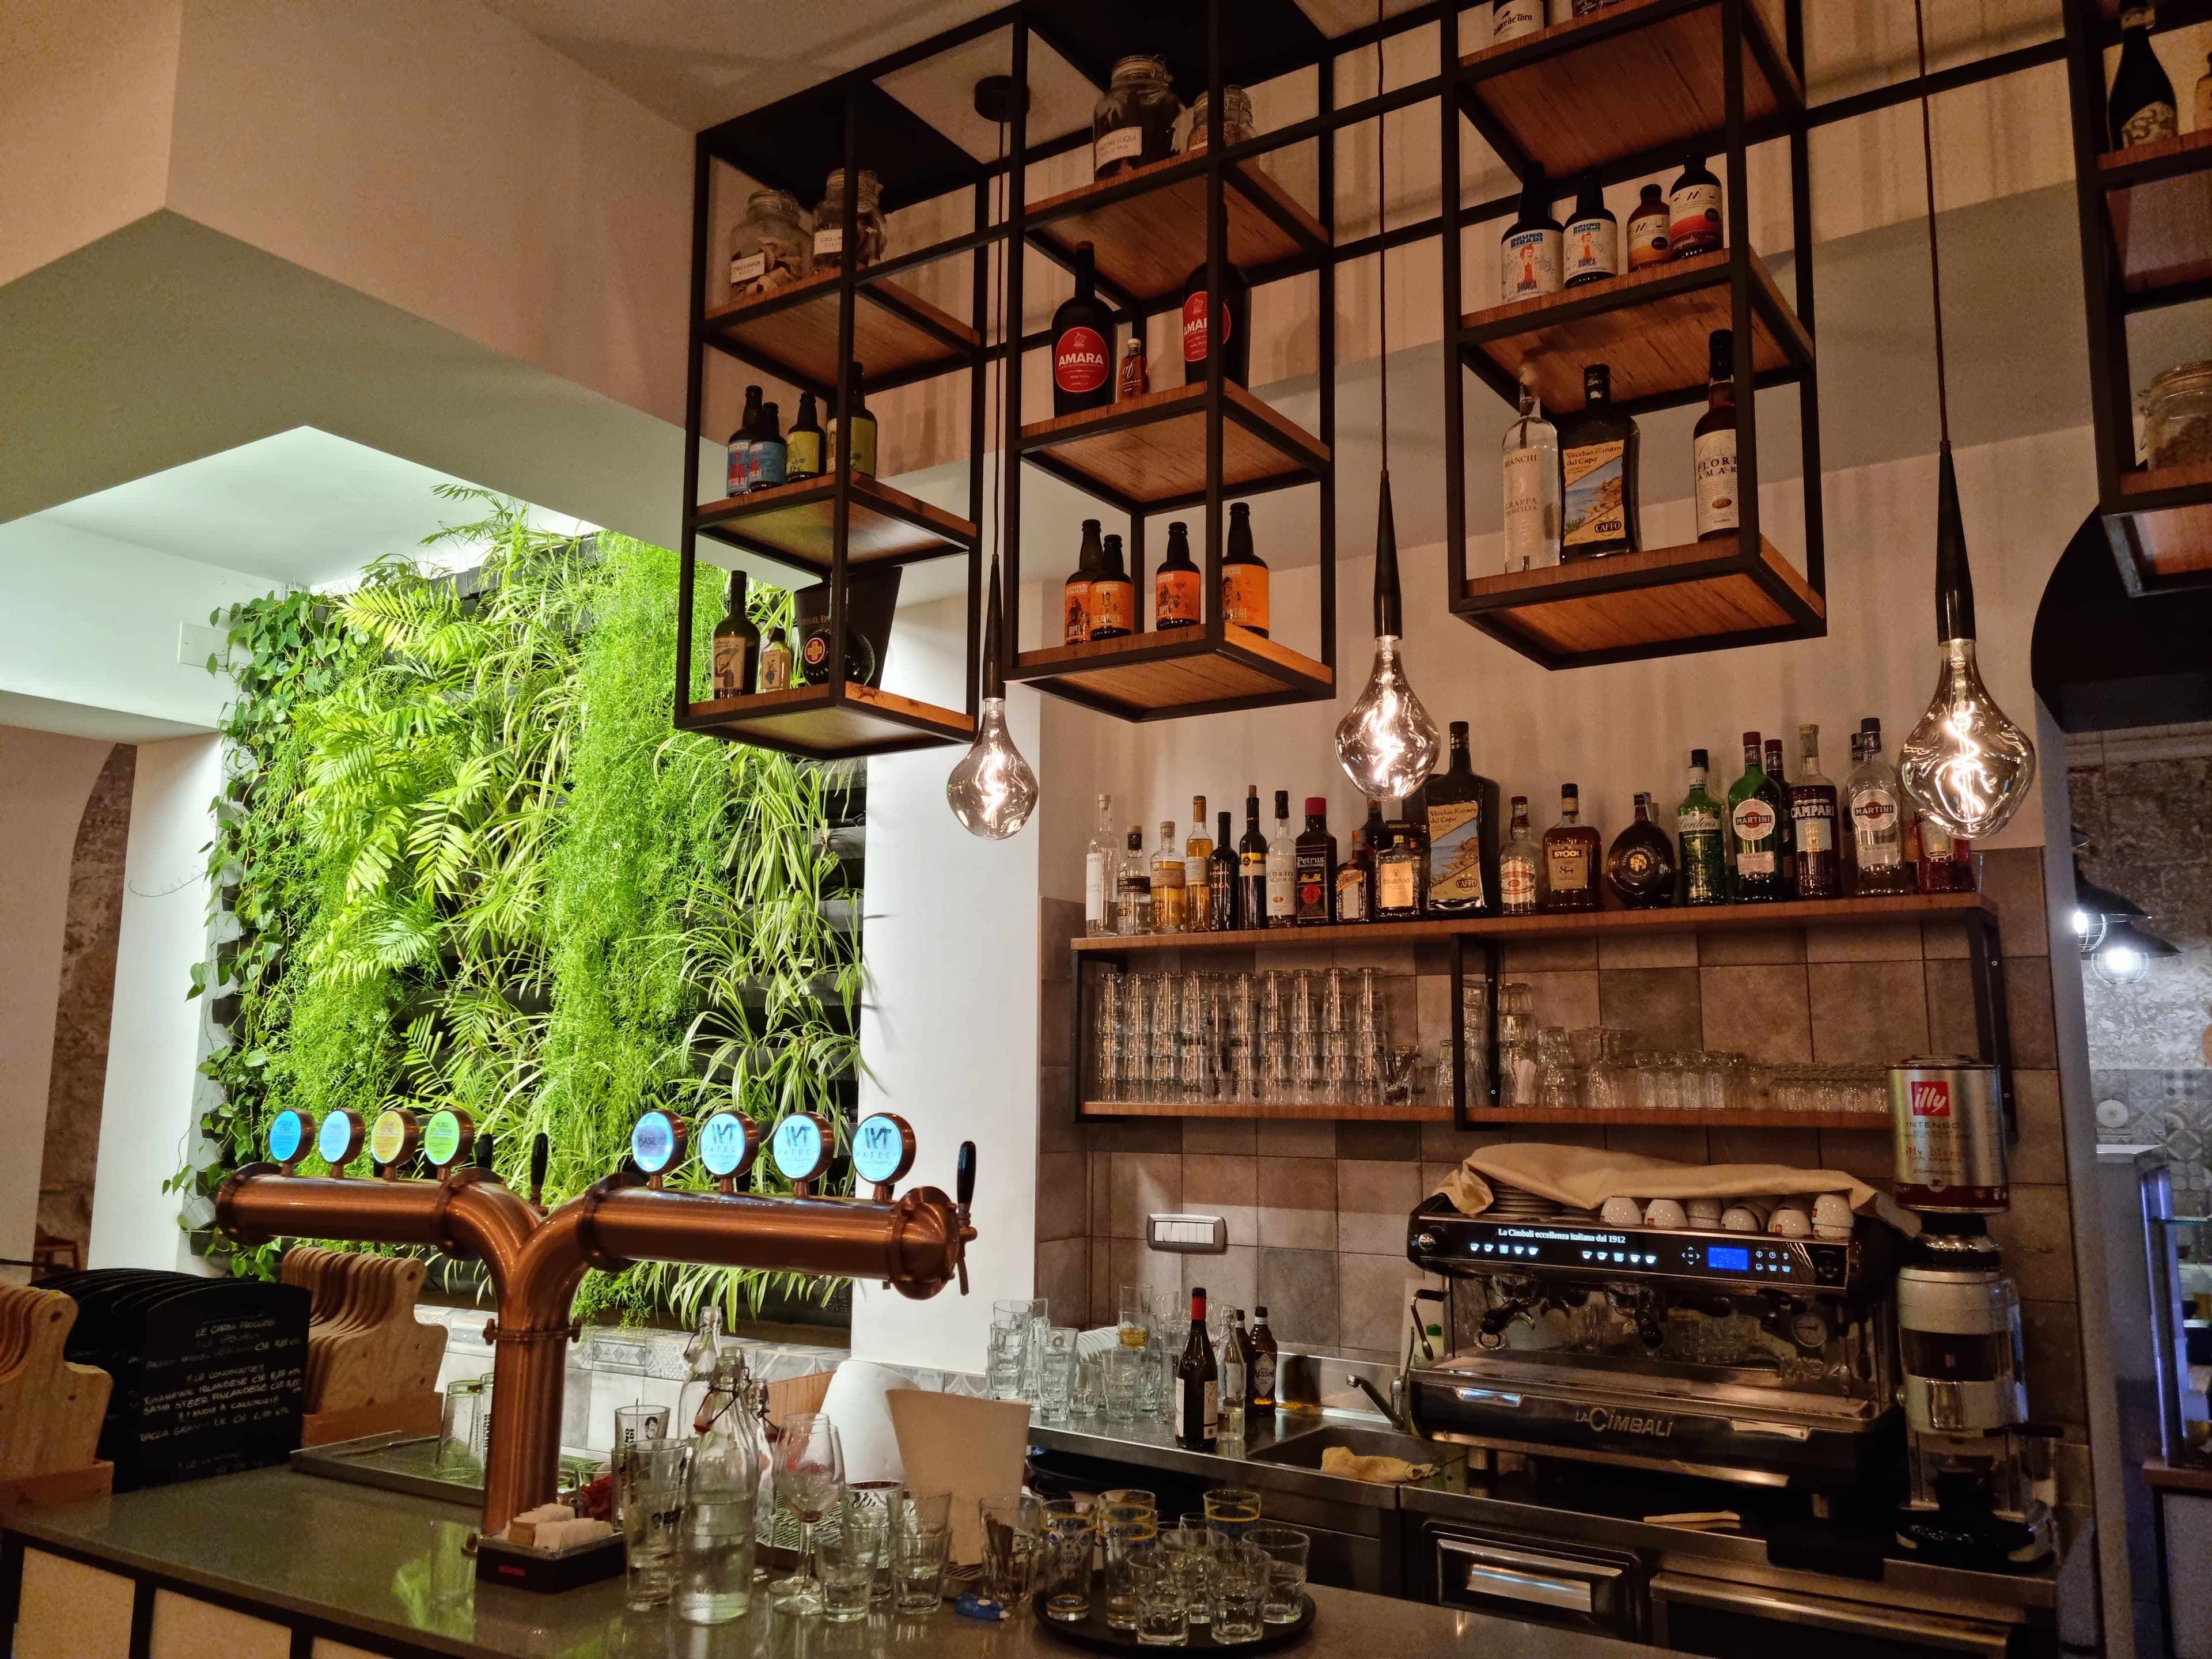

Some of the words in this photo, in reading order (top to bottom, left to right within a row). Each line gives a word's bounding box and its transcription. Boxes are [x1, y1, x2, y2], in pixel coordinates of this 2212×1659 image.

[1517, 13, 1532, 21] Toro
[1574, 222, 1601, 231] BRUNO
[1510, 232, 1543, 244] BRUNO
[1578, 257, 1596, 268] BIANCA
[1517, 279, 1537, 293] BIANCA
[1058, 352, 1104, 367] AMARA
[1504, 454, 1537, 468] BIANCHI
[1566, 450, 1593, 459] Vecchio
[1578, 457, 1597, 465] Capo
[1698, 456, 1737, 474] FLORI
[1698, 466, 1737, 482] AMAR
[1505, 497, 1537, 511] GRAPPA
[1596, 521, 1621, 533] CAFFO
[1238, 608, 1248, 618] ALE
[1791, 805, 1835, 819] CAMPARI
[1855, 805, 1893, 815] MARTINI
[1680, 817, 1715, 830] Gordon's
[1736, 816, 1771, 825] MARTINI
[1622, 848, 1636, 866] VECCHIA
[1636, 847, 1655, 865] ROMAGNA
[1914, 1086, 1947, 1113] illy
[1907, 1121, 1959, 1129] INTENSO
[1498, 1228, 1508, 1236] La
[1508, 1229, 1535, 1238] Cimbali
[1535, 1231, 1569, 1240] eccellenza
[1570, 1233, 1595, 1241] italiana
[1596, 1234, 1607, 1243] dal
[1608, 1236, 1626, 1244] 1912
[213, 1384, 268, 1400] FINLANDESE
[1575, 1410, 1590, 1423] LA
[1589, 1407, 1673, 1437] CIMBALI
